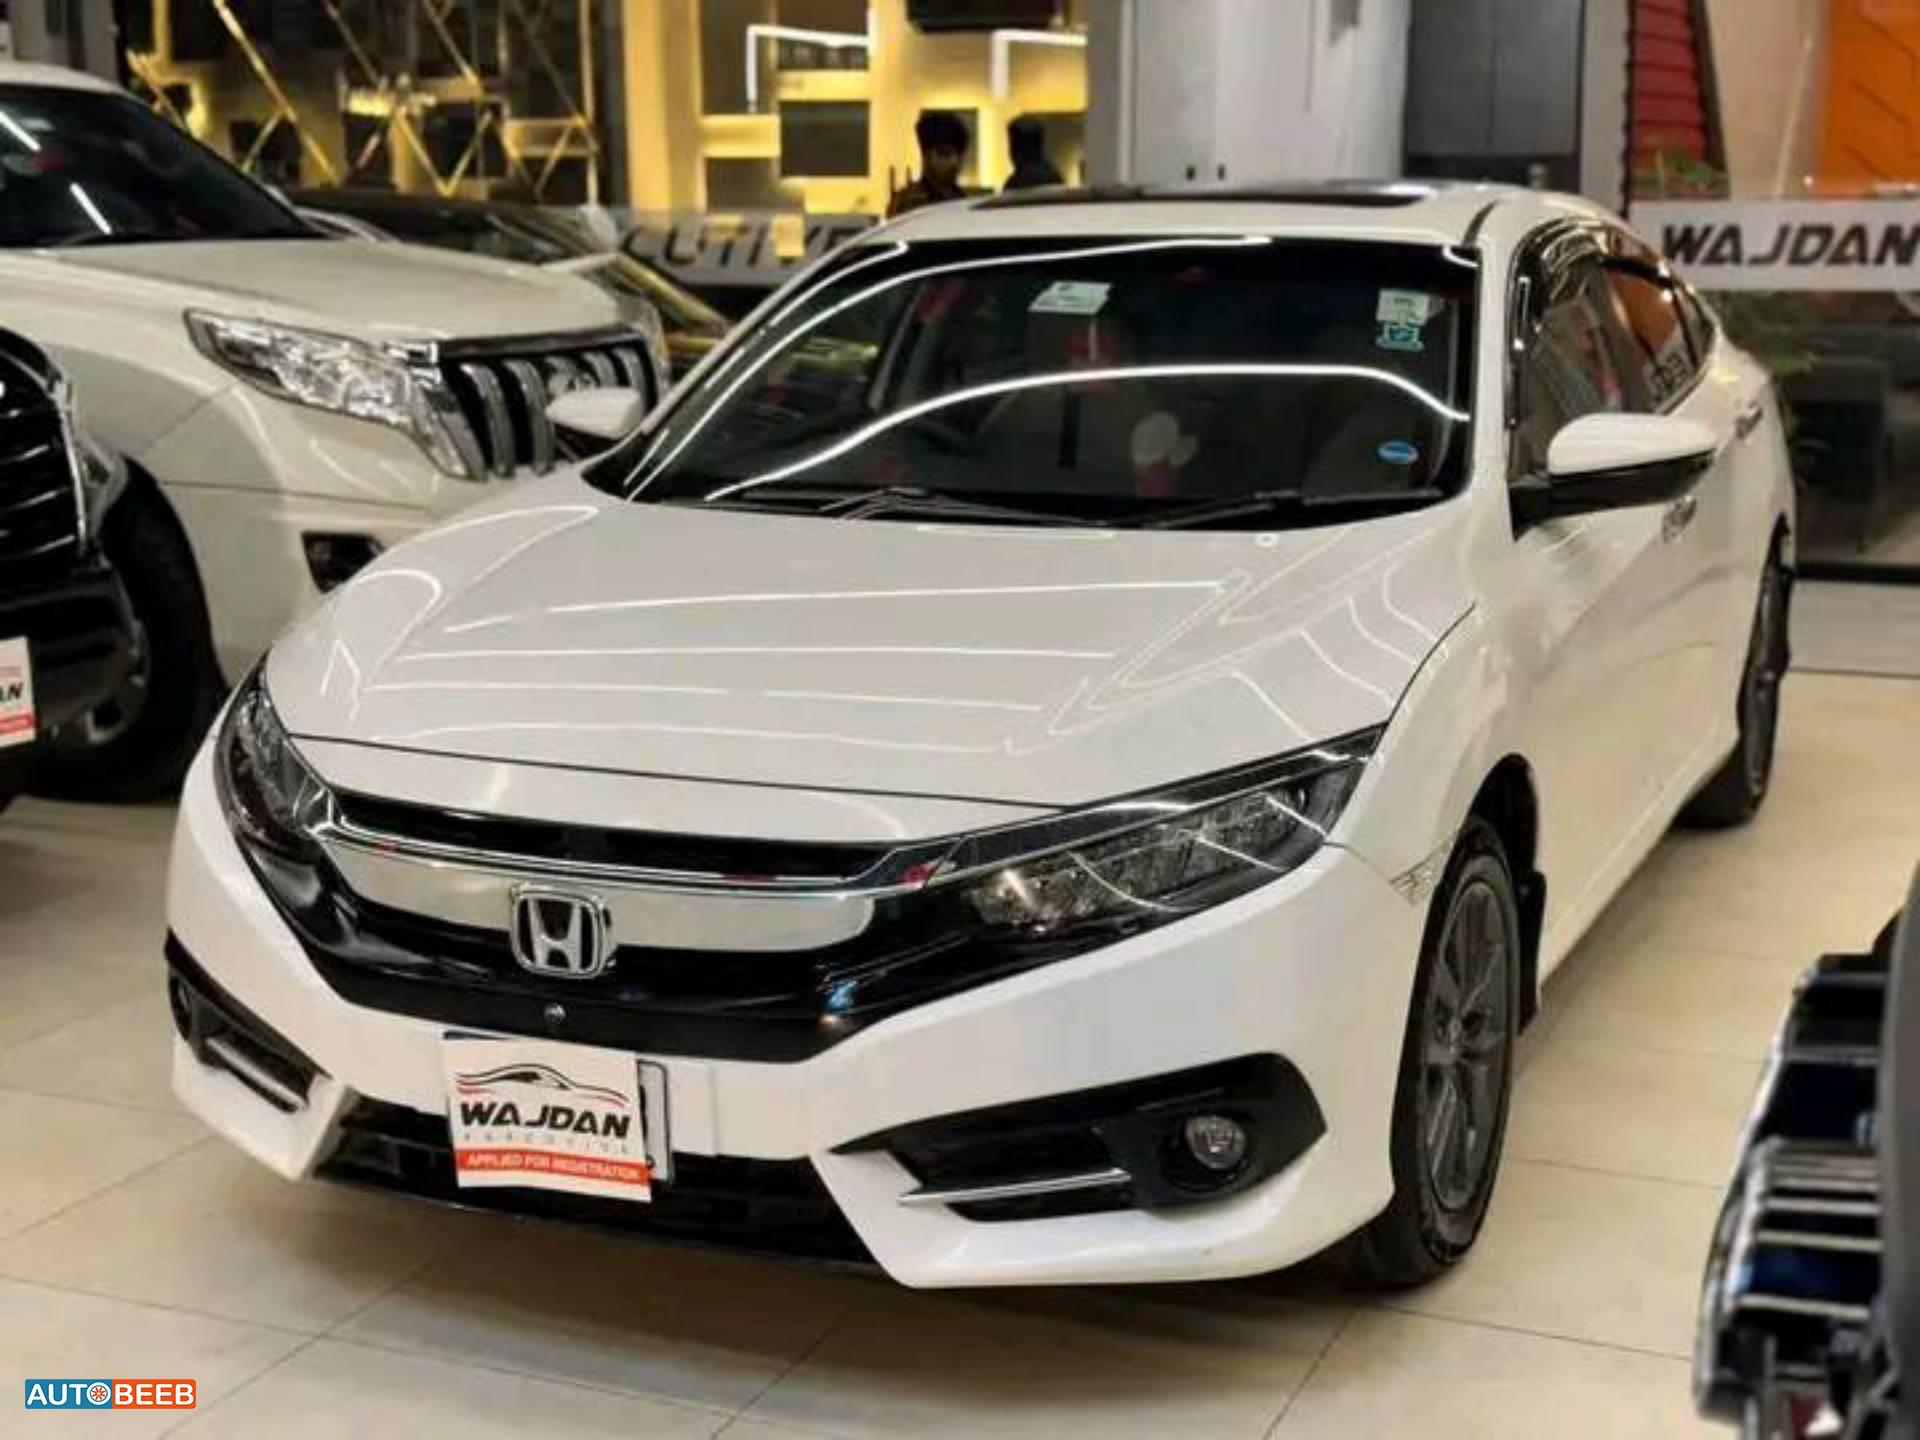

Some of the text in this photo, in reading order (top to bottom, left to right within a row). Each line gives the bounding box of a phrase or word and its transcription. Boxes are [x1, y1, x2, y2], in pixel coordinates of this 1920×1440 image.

[1663, 223, 1920, 266] WAJDAN
[460, 1102, 630, 1139] WAJDAN
[467, 1152, 523, 1169] APPLIED
[524, 1153, 549, 1170] FOR
